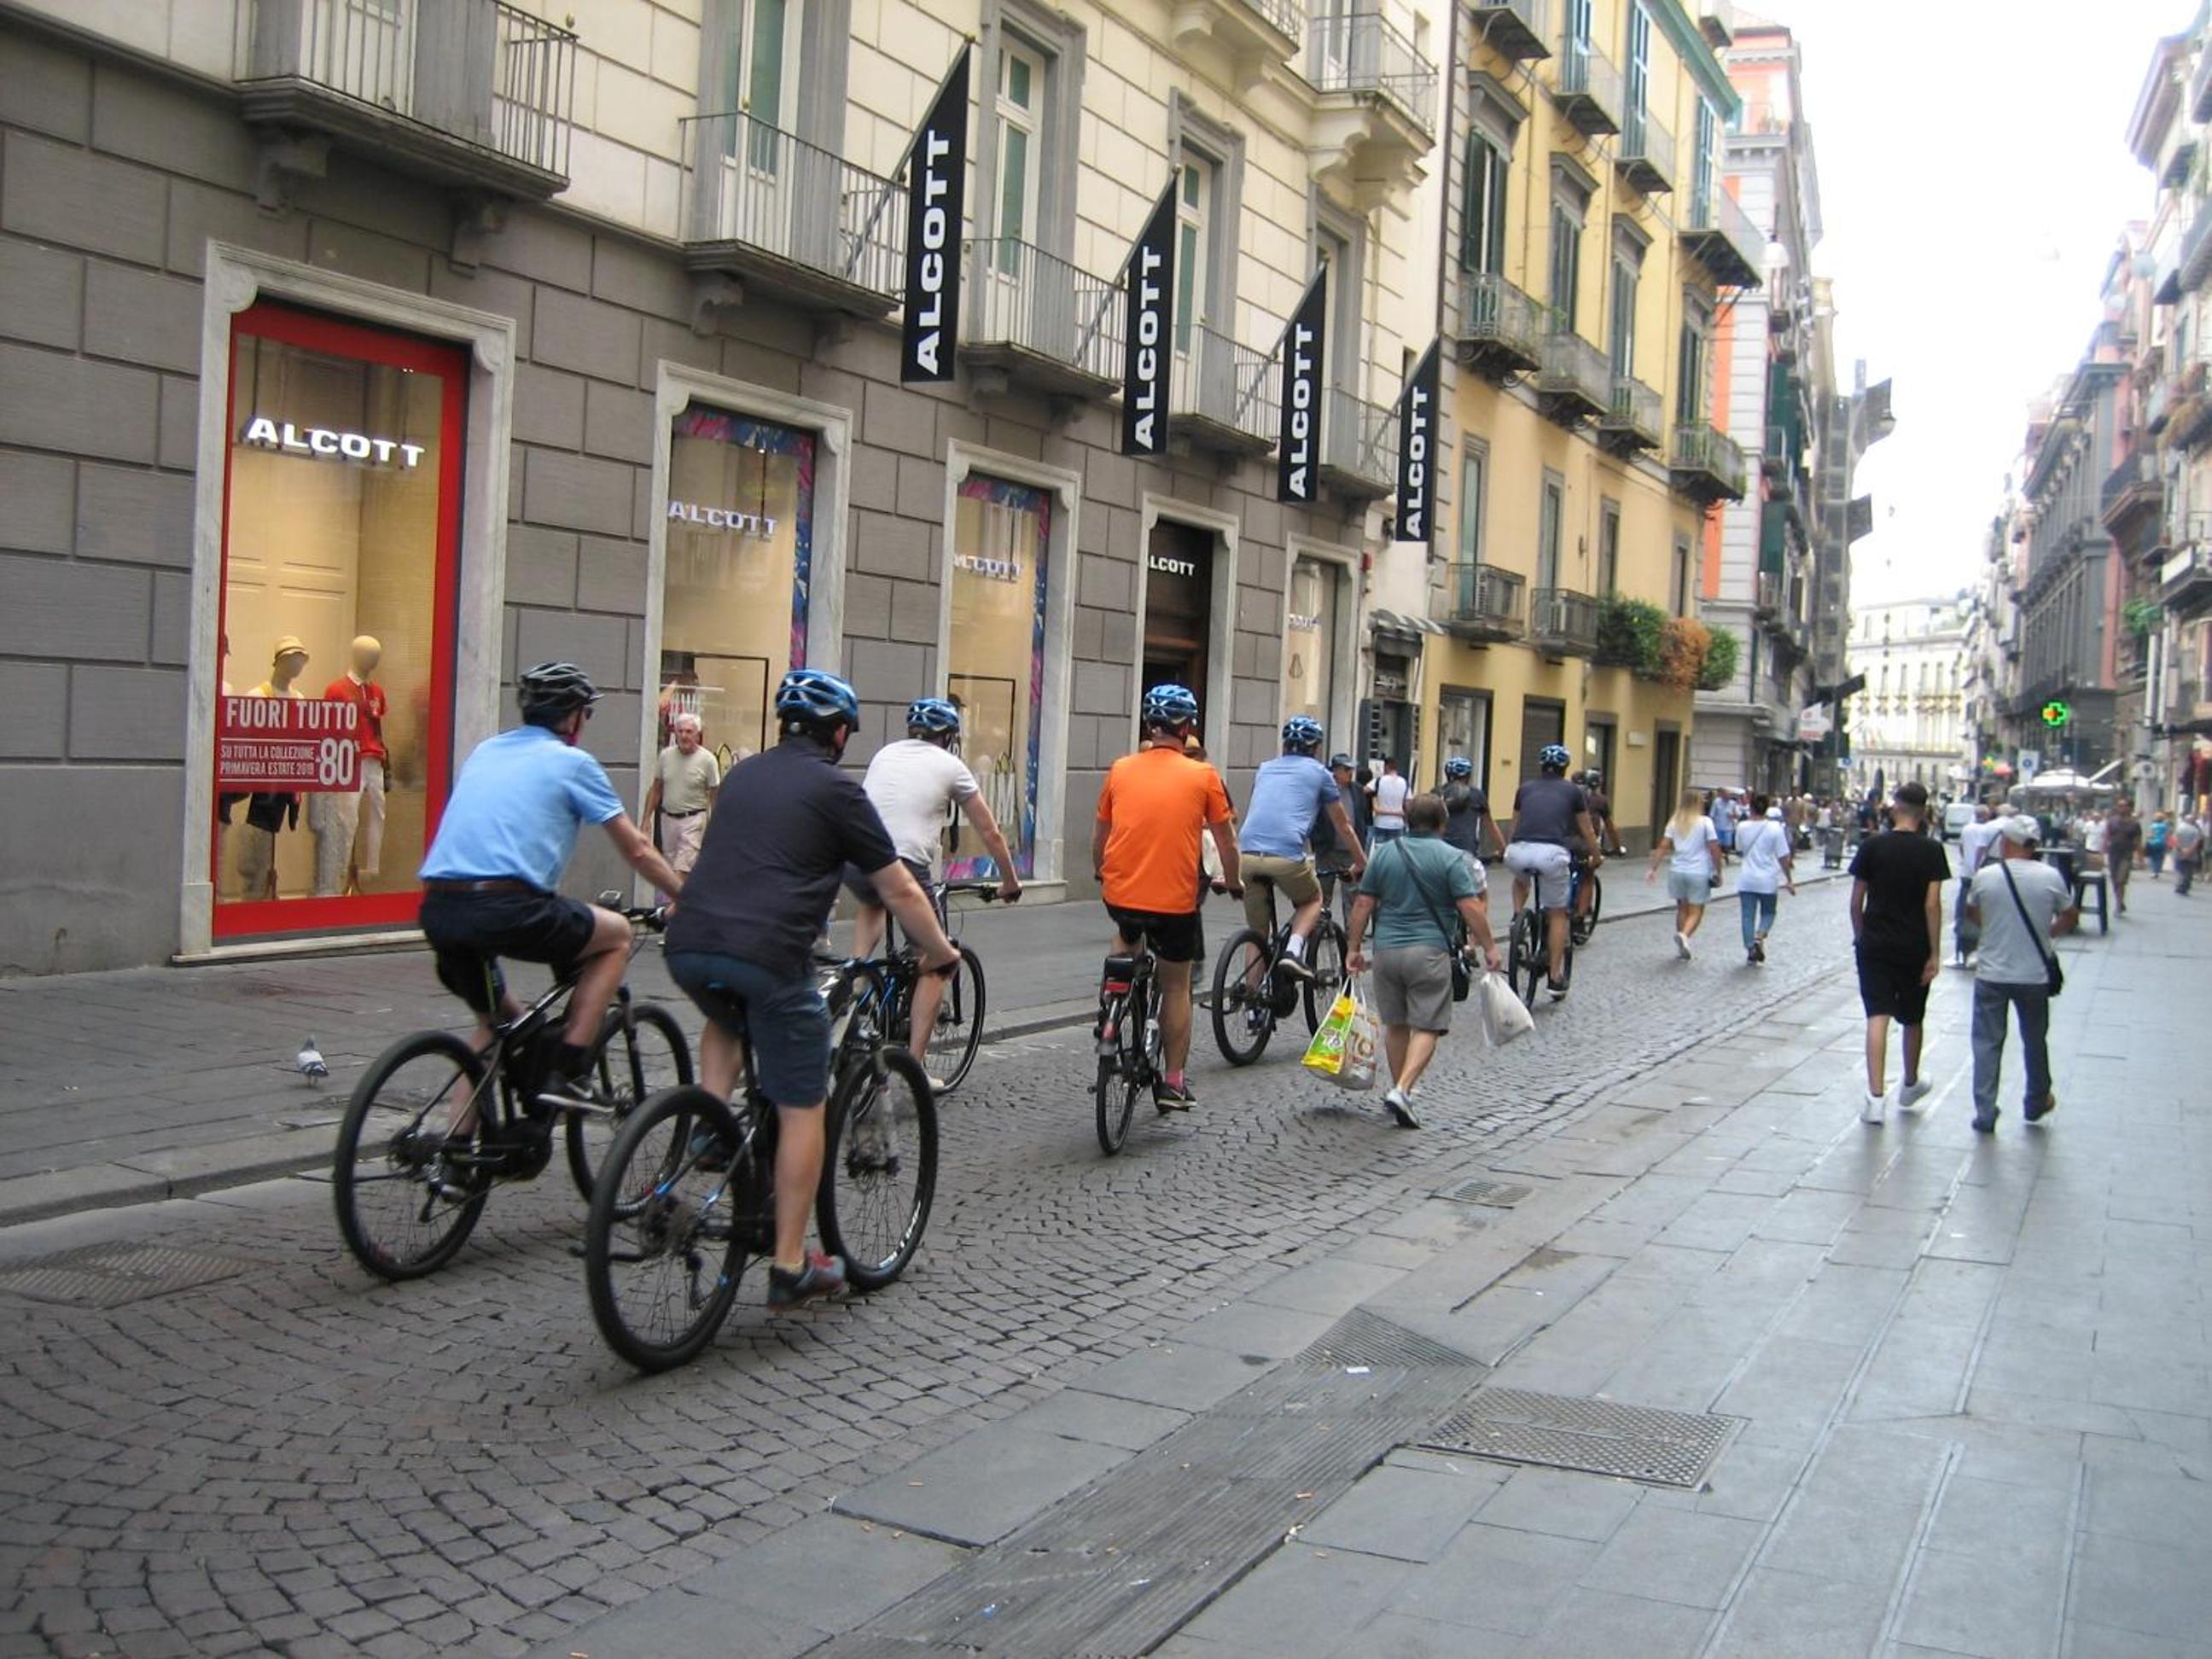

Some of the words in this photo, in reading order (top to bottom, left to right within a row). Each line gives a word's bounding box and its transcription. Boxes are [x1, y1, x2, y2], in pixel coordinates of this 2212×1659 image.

[917, 129, 949, 375] ALCOTT
[1135, 246, 1161, 451] ALCOTT
[1289, 323, 1313, 498] ALCOTT
[247, 417, 425, 467] ALCOTT
[1406, 386, 1428, 538] ALCOTT
[668, 500, 777, 534] ALCOTT
[1148, 555, 1195, 576] LCOTT
[226, 698, 288, 728] FUORI
[297, 701, 358, 731] TUTTO
[259, 745, 269, 759] LA
